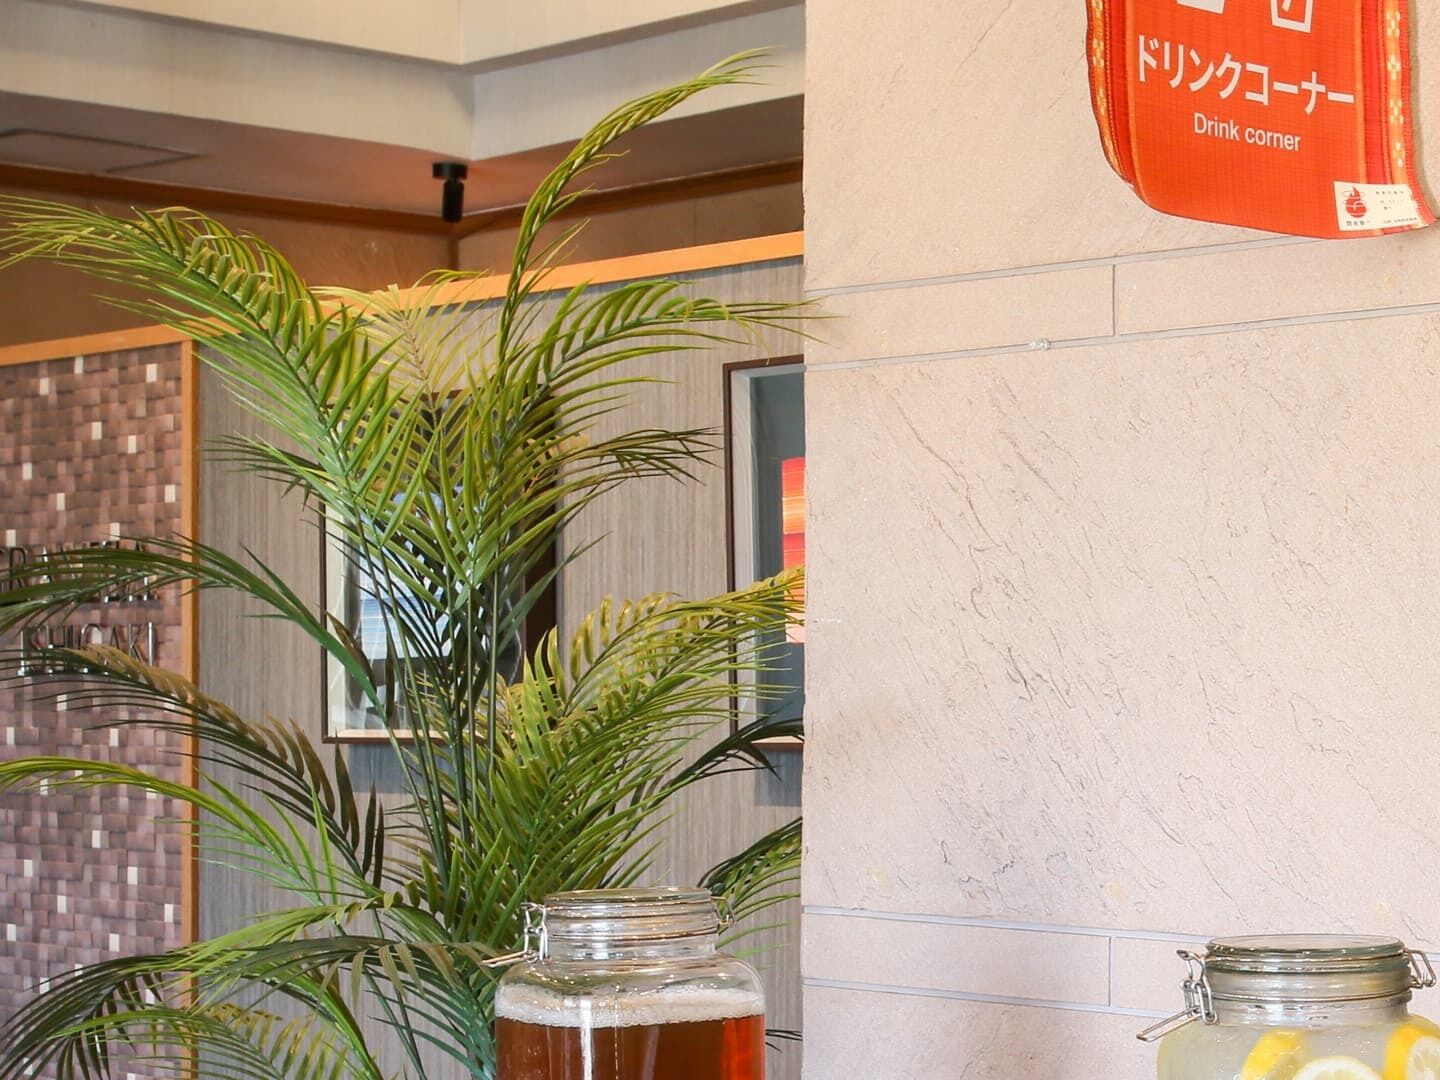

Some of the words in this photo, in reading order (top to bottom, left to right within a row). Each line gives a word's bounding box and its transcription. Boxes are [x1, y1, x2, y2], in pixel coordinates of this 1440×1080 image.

[1138, 35, 1354, 114] ドリンクコーナー
[1193, 112, 1240, 141] Drink
[1244, 127, 1301, 151] corner
